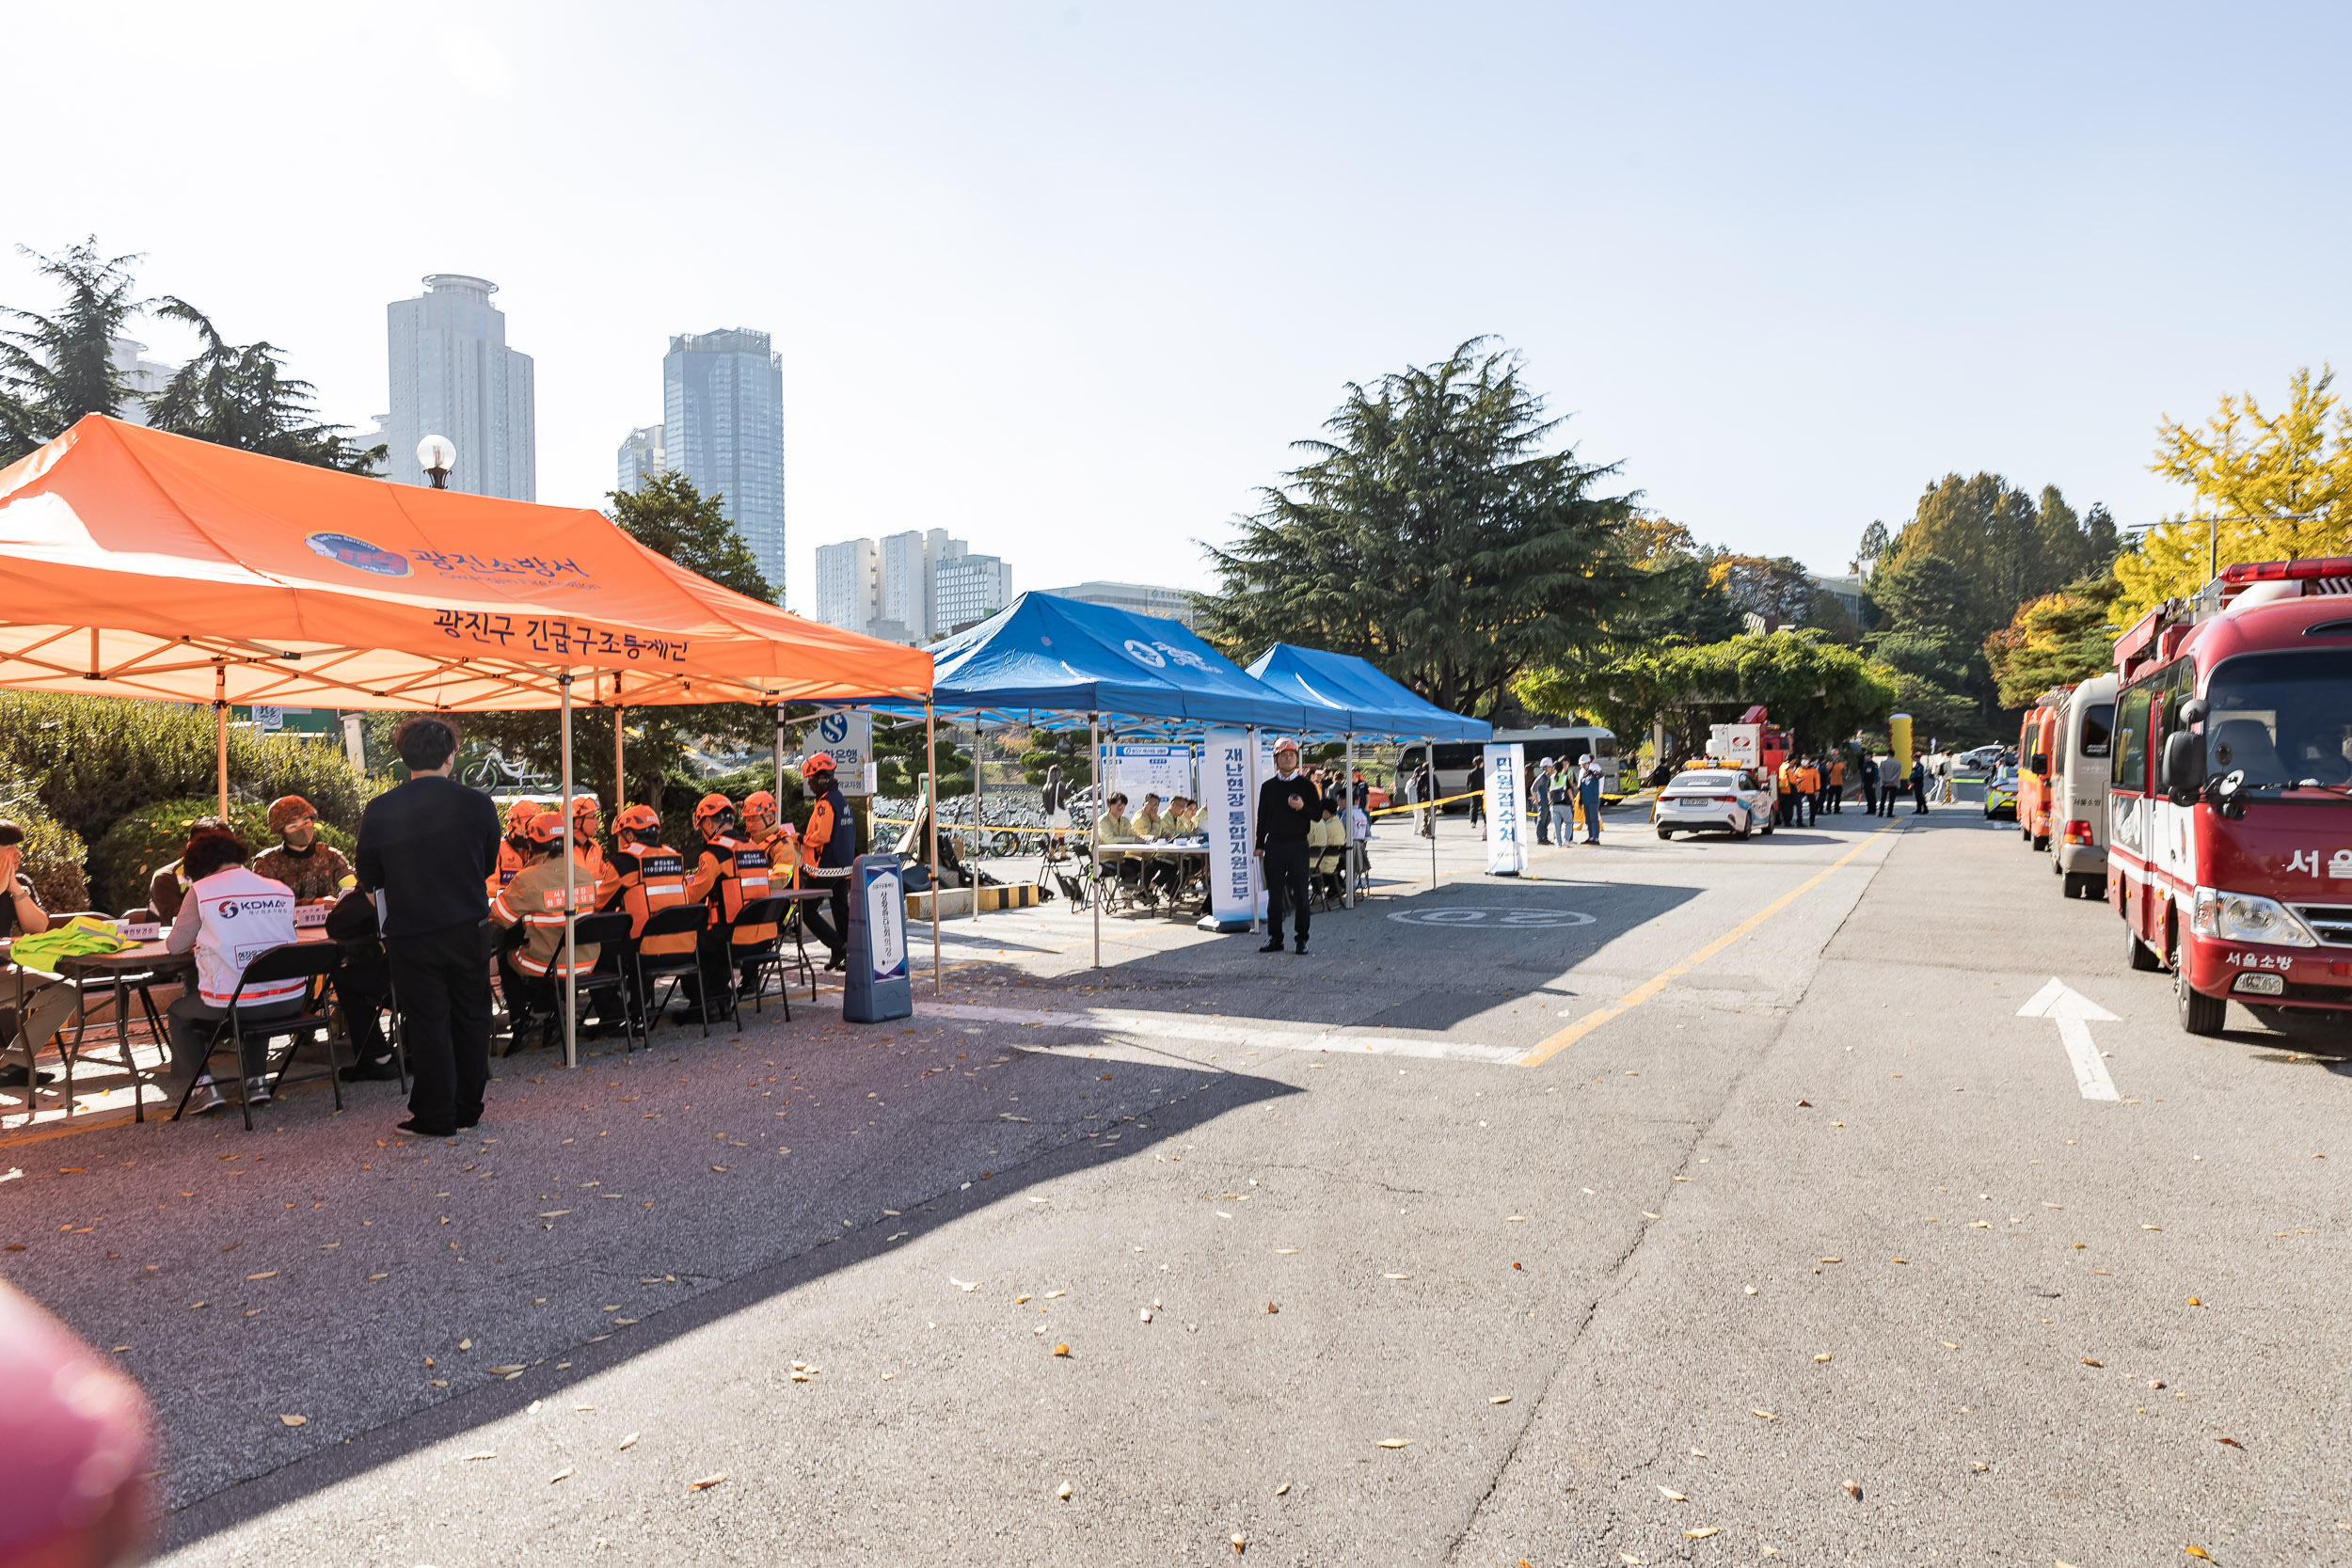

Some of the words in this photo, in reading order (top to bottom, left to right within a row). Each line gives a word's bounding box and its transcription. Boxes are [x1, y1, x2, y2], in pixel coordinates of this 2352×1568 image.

[409, 549, 590, 578] 광진소방서
[434, 609, 515, 645] 광진구
[1225, 748, 1245, 807] 재난현장
[1228, 811, 1249, 900] 통합지원본부
[2226, 951, 2293, 971] 서울소방
